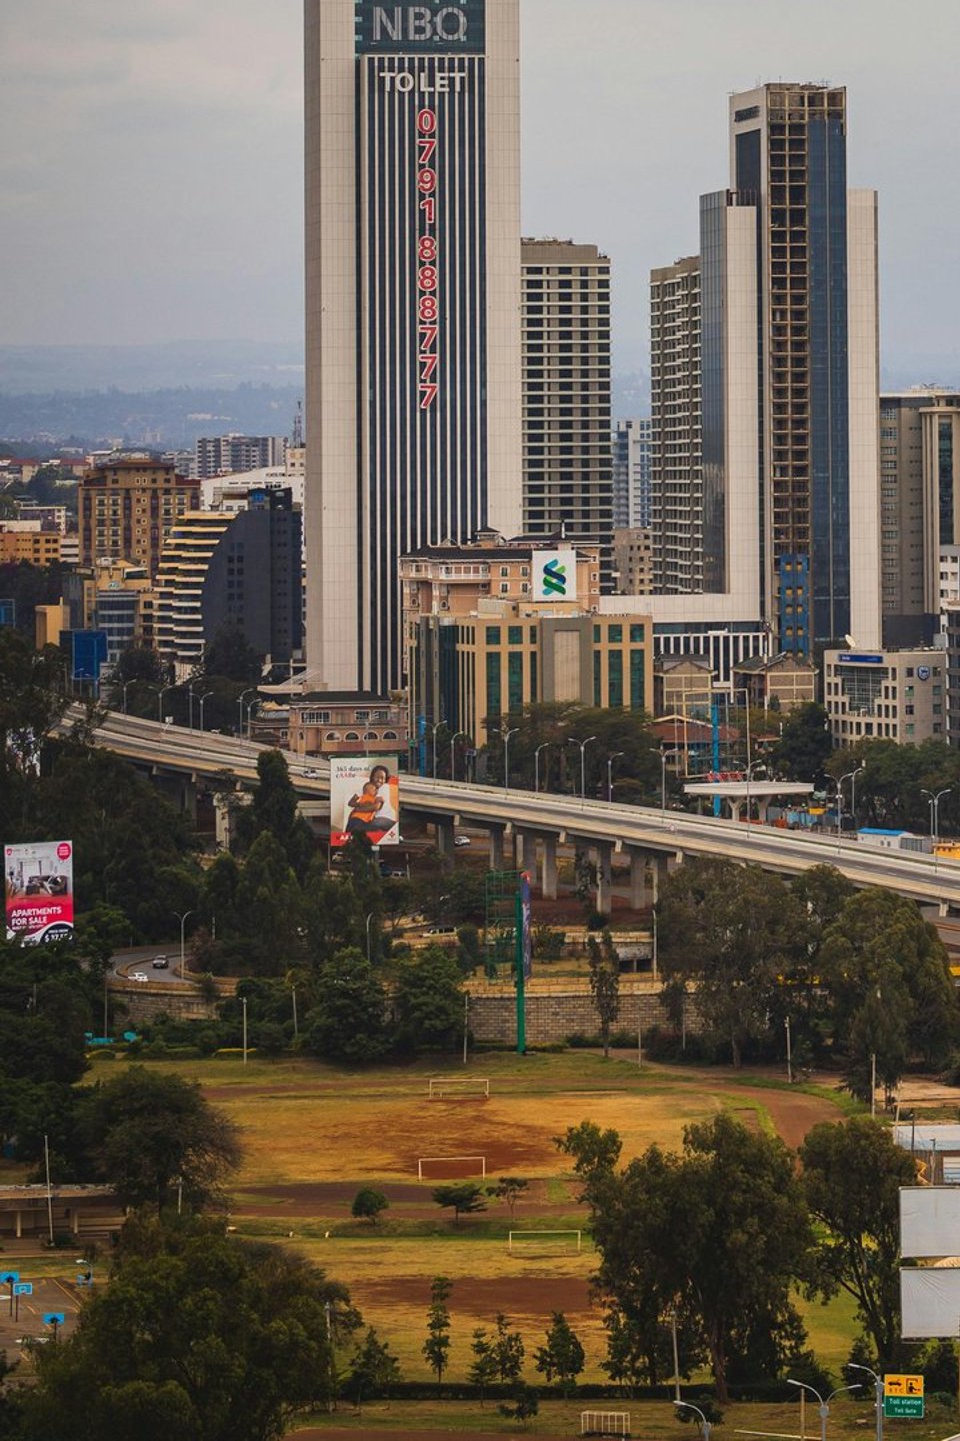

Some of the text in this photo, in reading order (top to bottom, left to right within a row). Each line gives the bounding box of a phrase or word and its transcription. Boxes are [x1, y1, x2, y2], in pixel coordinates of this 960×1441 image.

[373, 6, 467, 41] NBO
[379, 71, 466, 93] TO LET
[11, 906, 62, 918] APARTMENTS
[11, 916, 47, 926] FOR SALE
